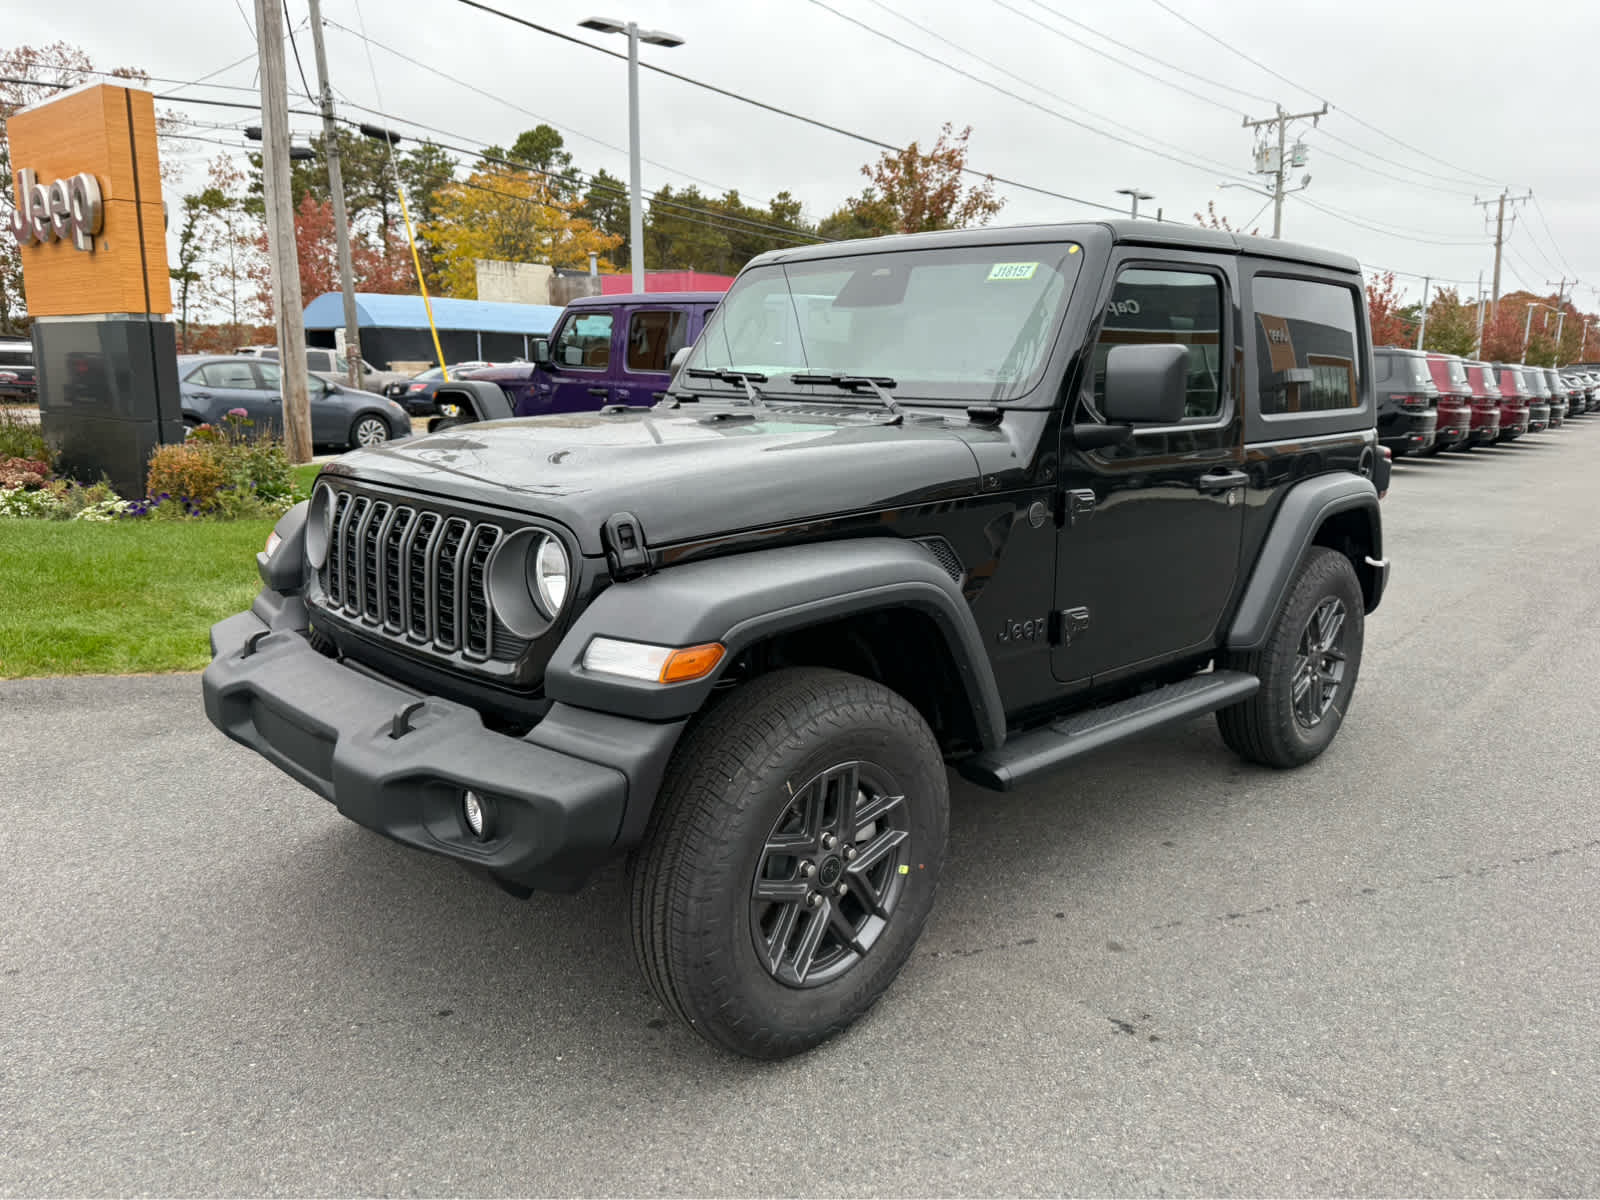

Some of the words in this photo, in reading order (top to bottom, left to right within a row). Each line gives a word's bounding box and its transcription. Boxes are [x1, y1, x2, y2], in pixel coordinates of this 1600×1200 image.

[11, 168, 103, 251] Jeep
[993, 265, 1033, 278] J18157
[997, 616, 1047, 642] Jeep
